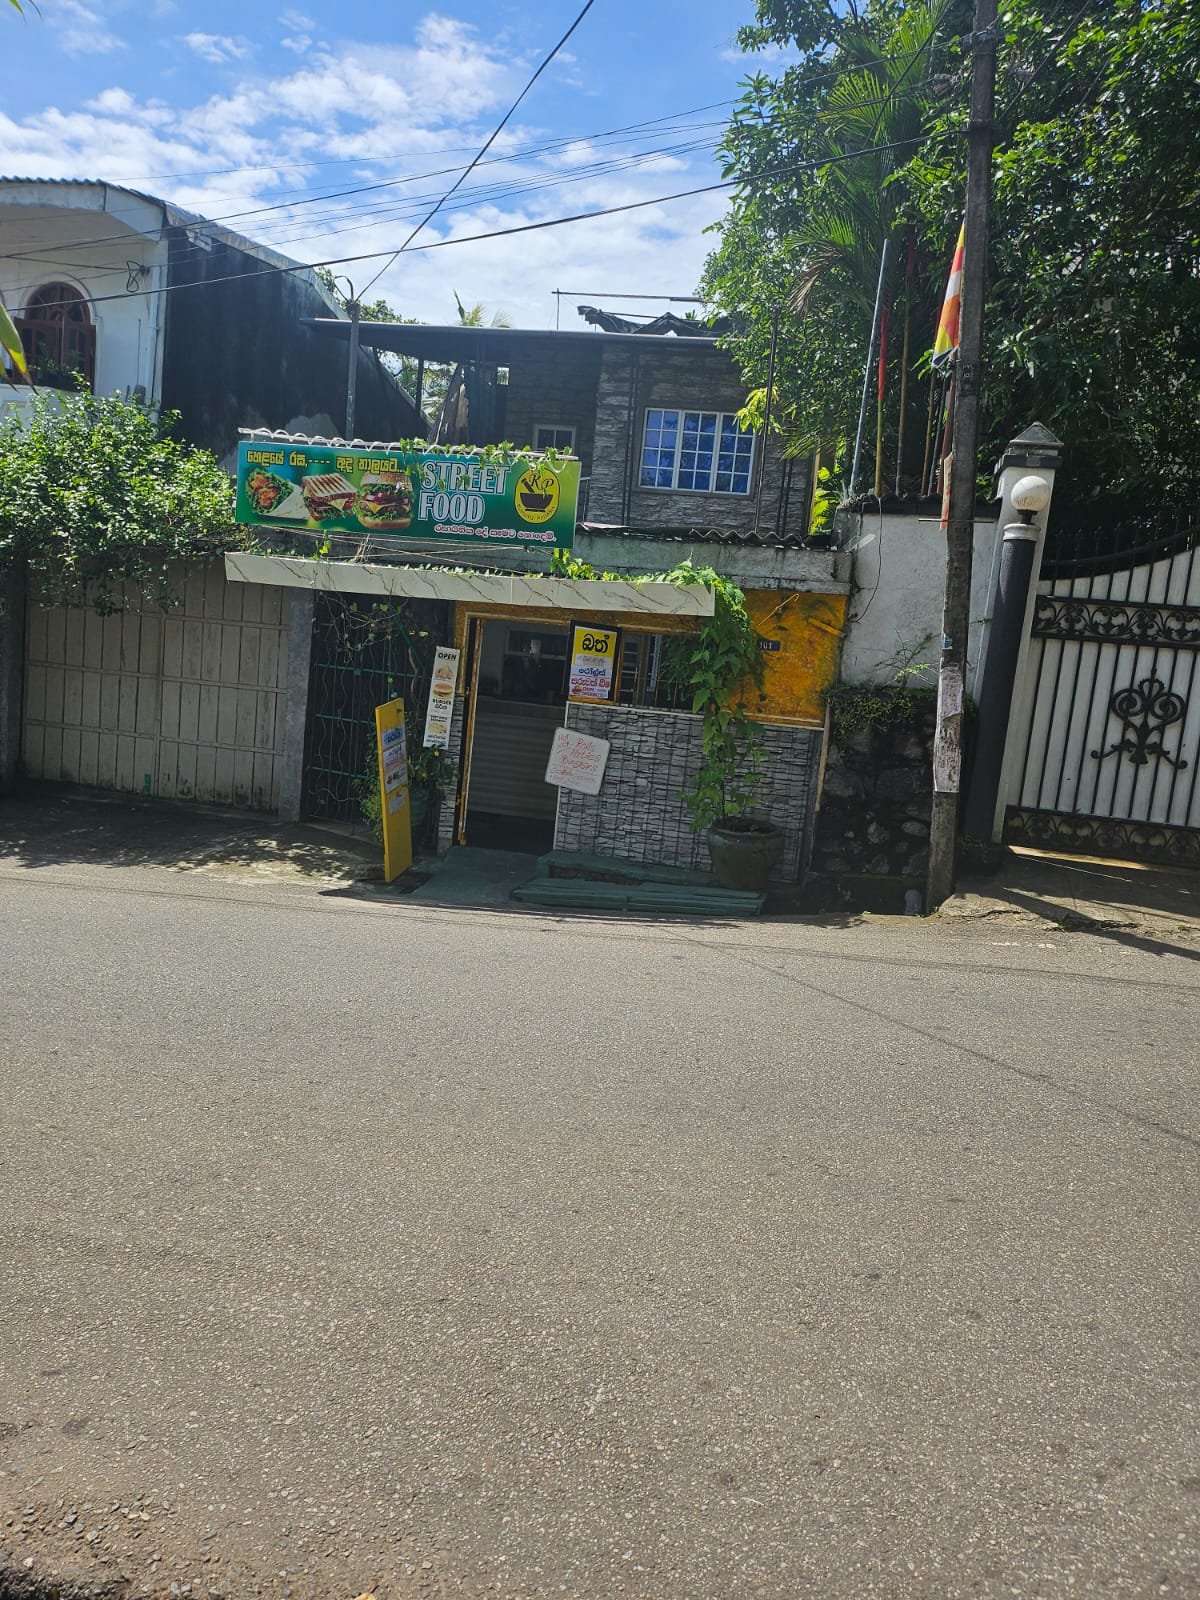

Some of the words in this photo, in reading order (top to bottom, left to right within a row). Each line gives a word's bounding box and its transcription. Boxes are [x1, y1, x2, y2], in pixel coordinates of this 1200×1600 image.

[421, 460, 511, 495] STREET
[418, 490, 485, 524] FOOD
[438, 652, 457, 661] OPEN
[582, 633, 610, 653] බත්
